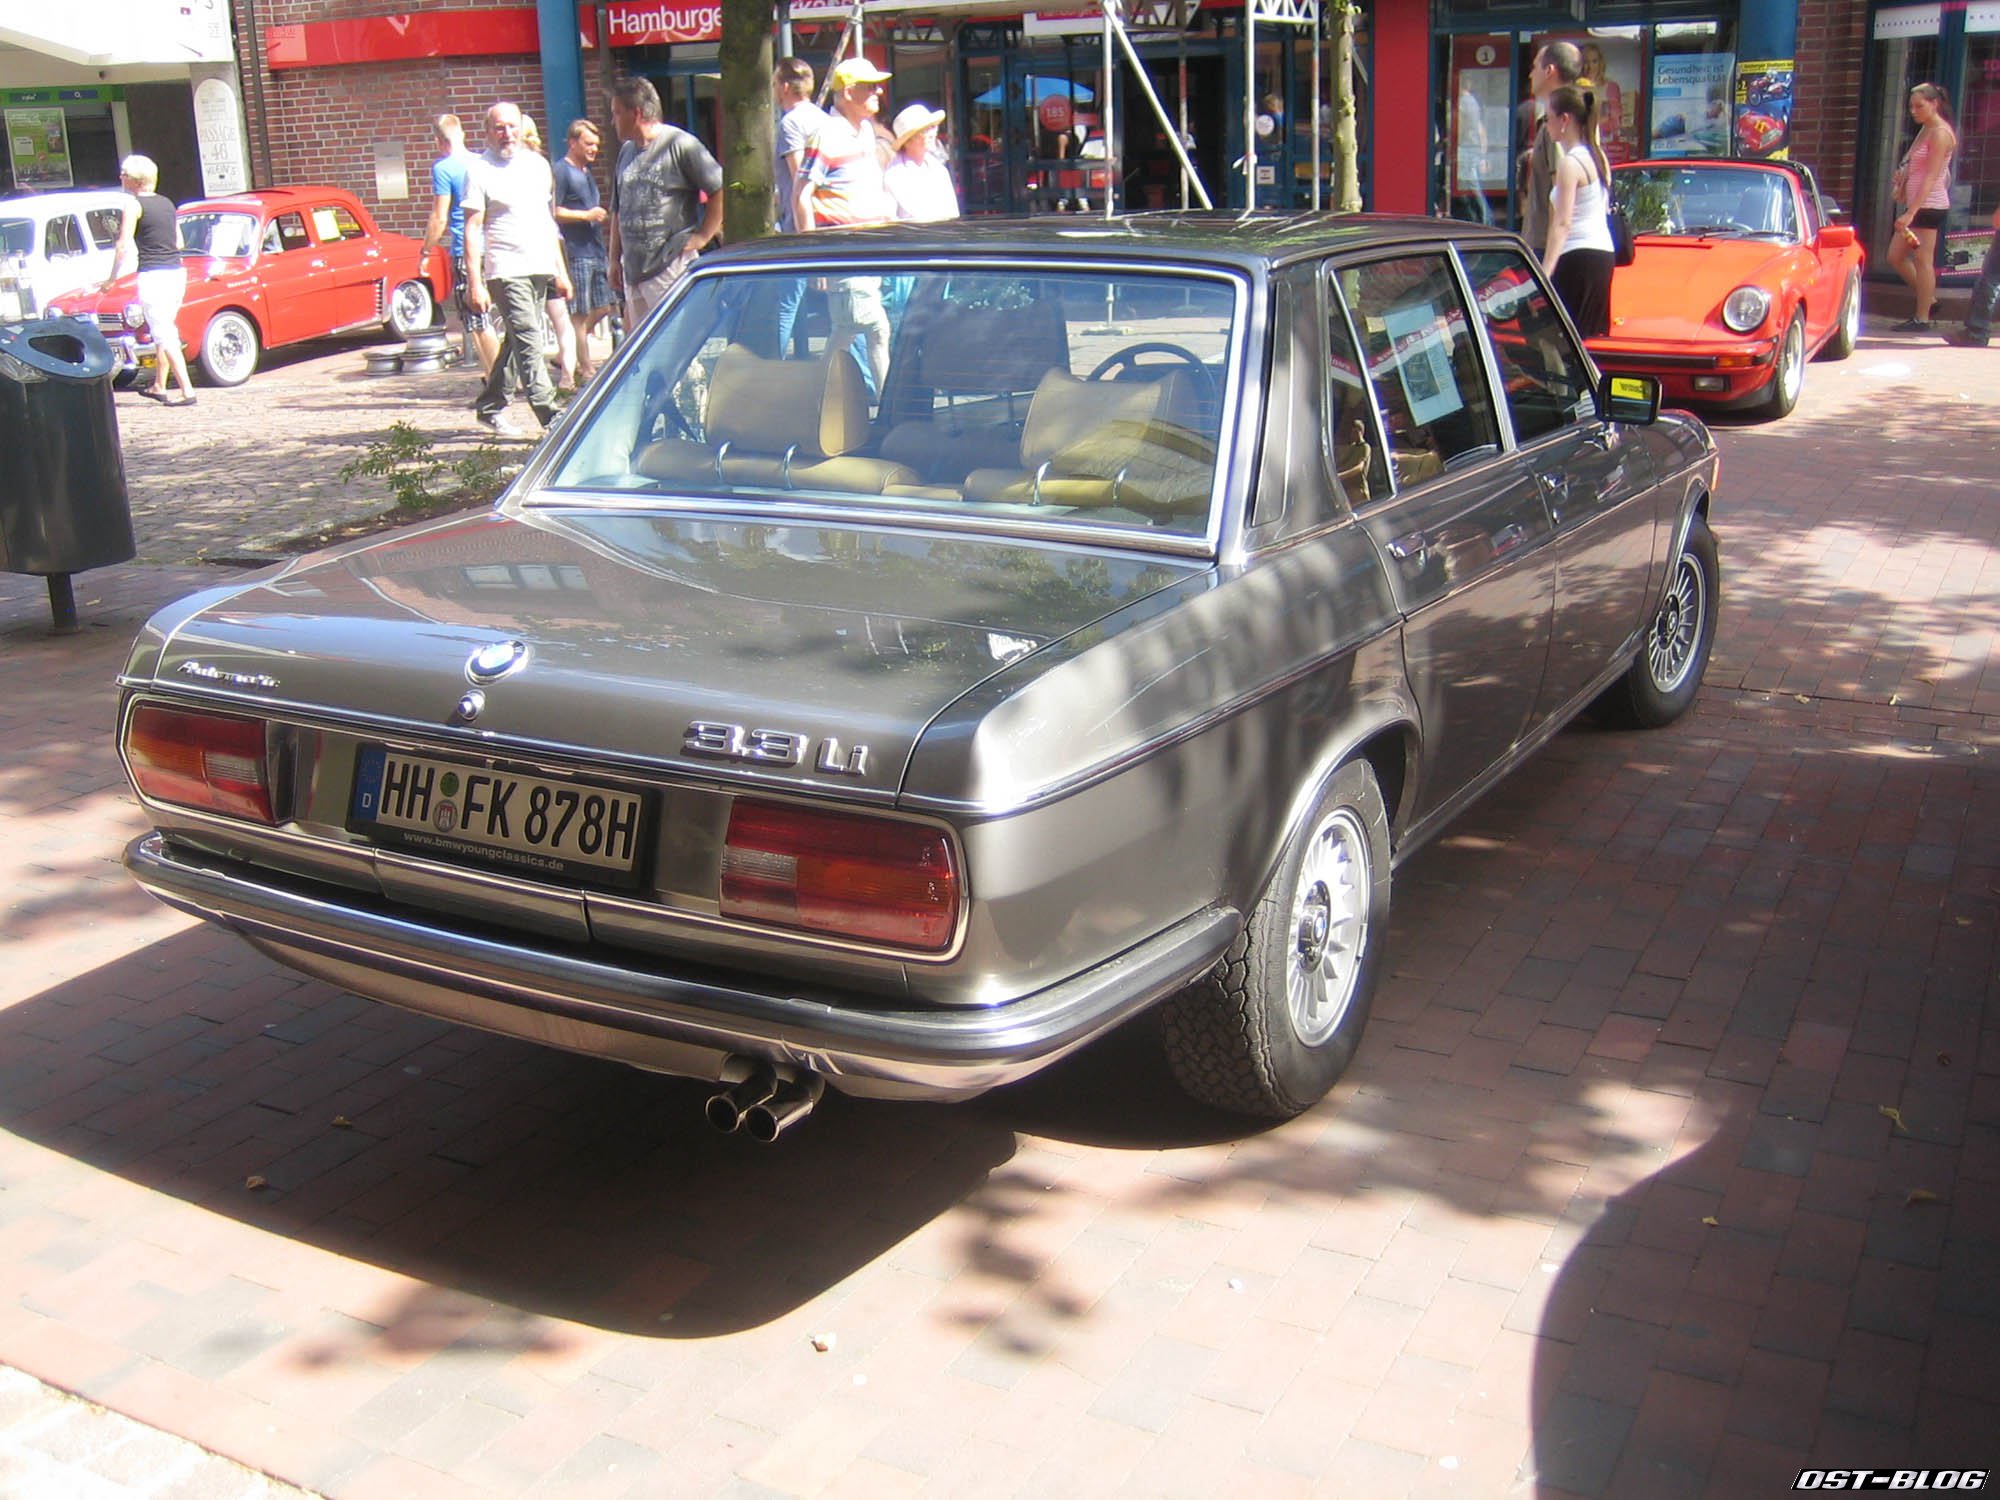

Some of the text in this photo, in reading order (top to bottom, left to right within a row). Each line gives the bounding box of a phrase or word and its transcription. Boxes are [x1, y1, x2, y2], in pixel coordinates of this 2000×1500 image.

[609, 5, 722, 35] Hamburge
[1657, 64, 1710, 75] Gesundheit
[361, 792, 372, 808] D
[381, 760, 638, 861] HH FK 878H
[402, 831, 565, 872] www.bmwyoungclassics.de
